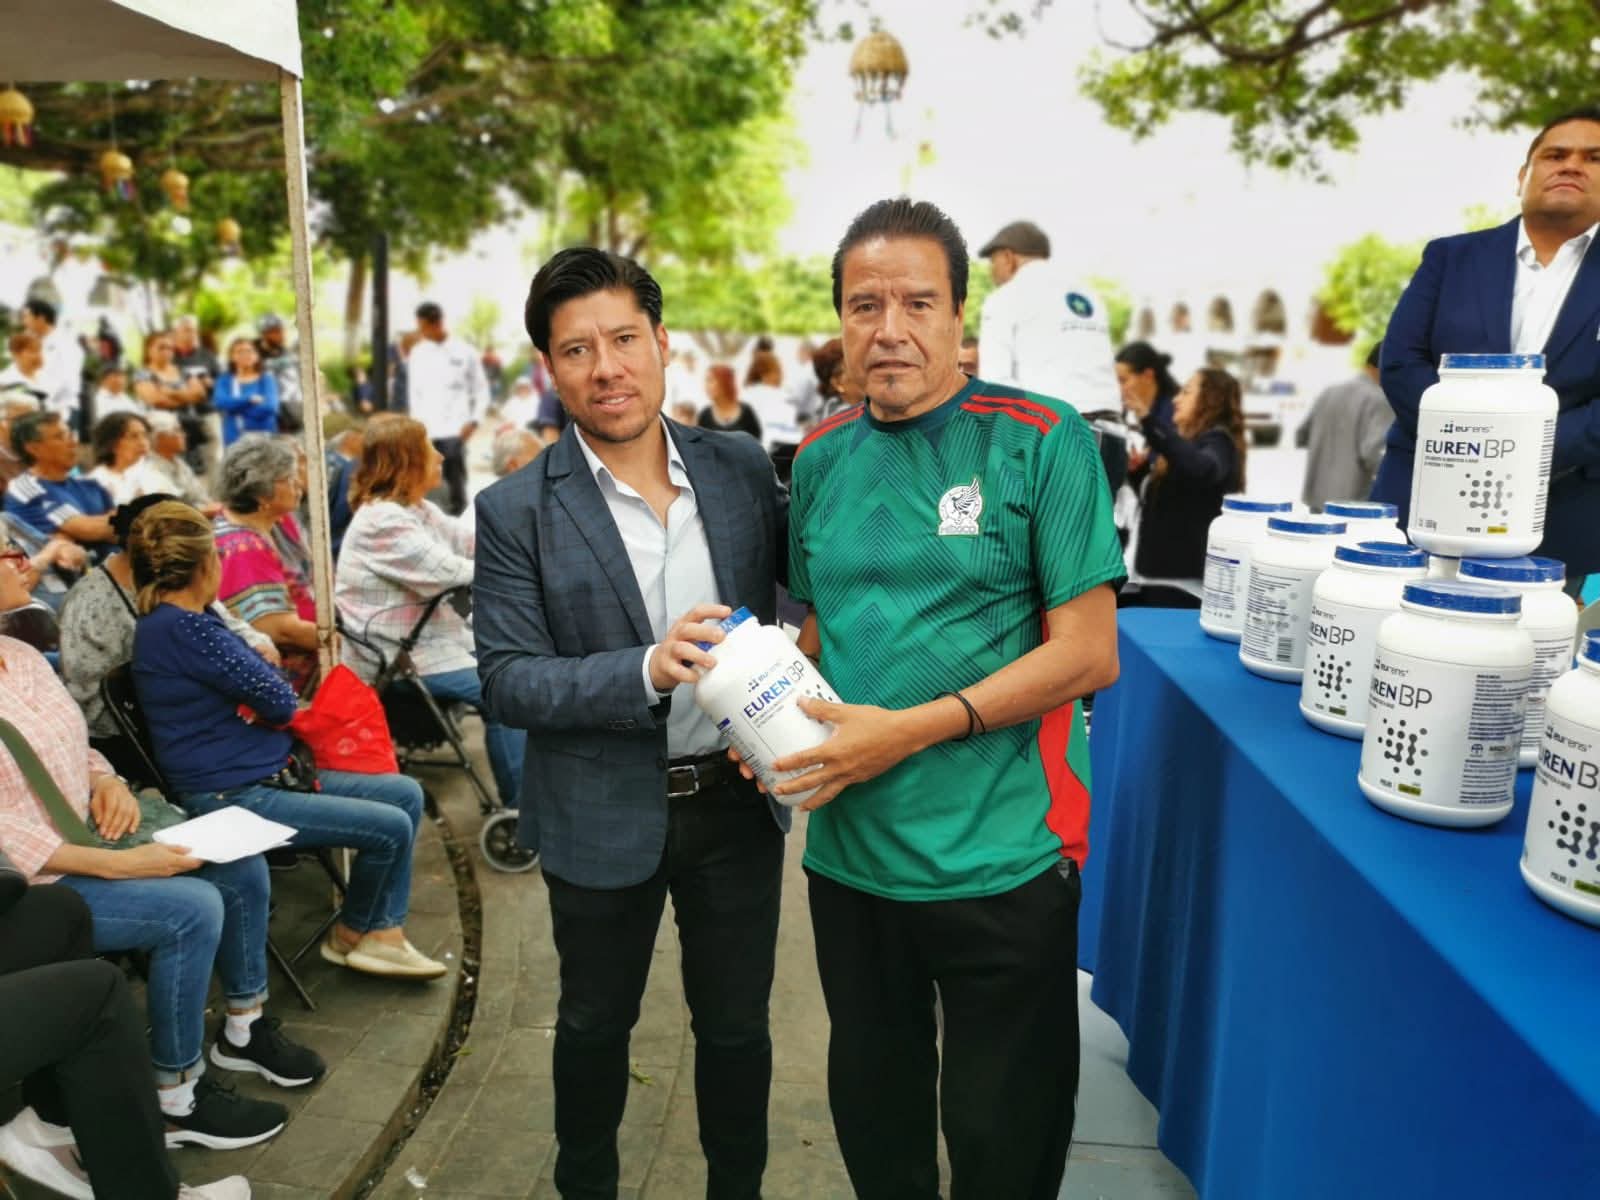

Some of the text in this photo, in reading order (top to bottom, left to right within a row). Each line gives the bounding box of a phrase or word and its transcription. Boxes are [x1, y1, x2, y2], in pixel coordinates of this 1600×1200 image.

[1425, 439, 1516, 459] EUREN BP
[1310, 621, 1328, 639] REN
[1329, 625, 1355, 646] BP
[743, 676, 792, 719] EUREN
[1399, 684, 1433, 709] BP
[1577, 760, 1600, 793] B
